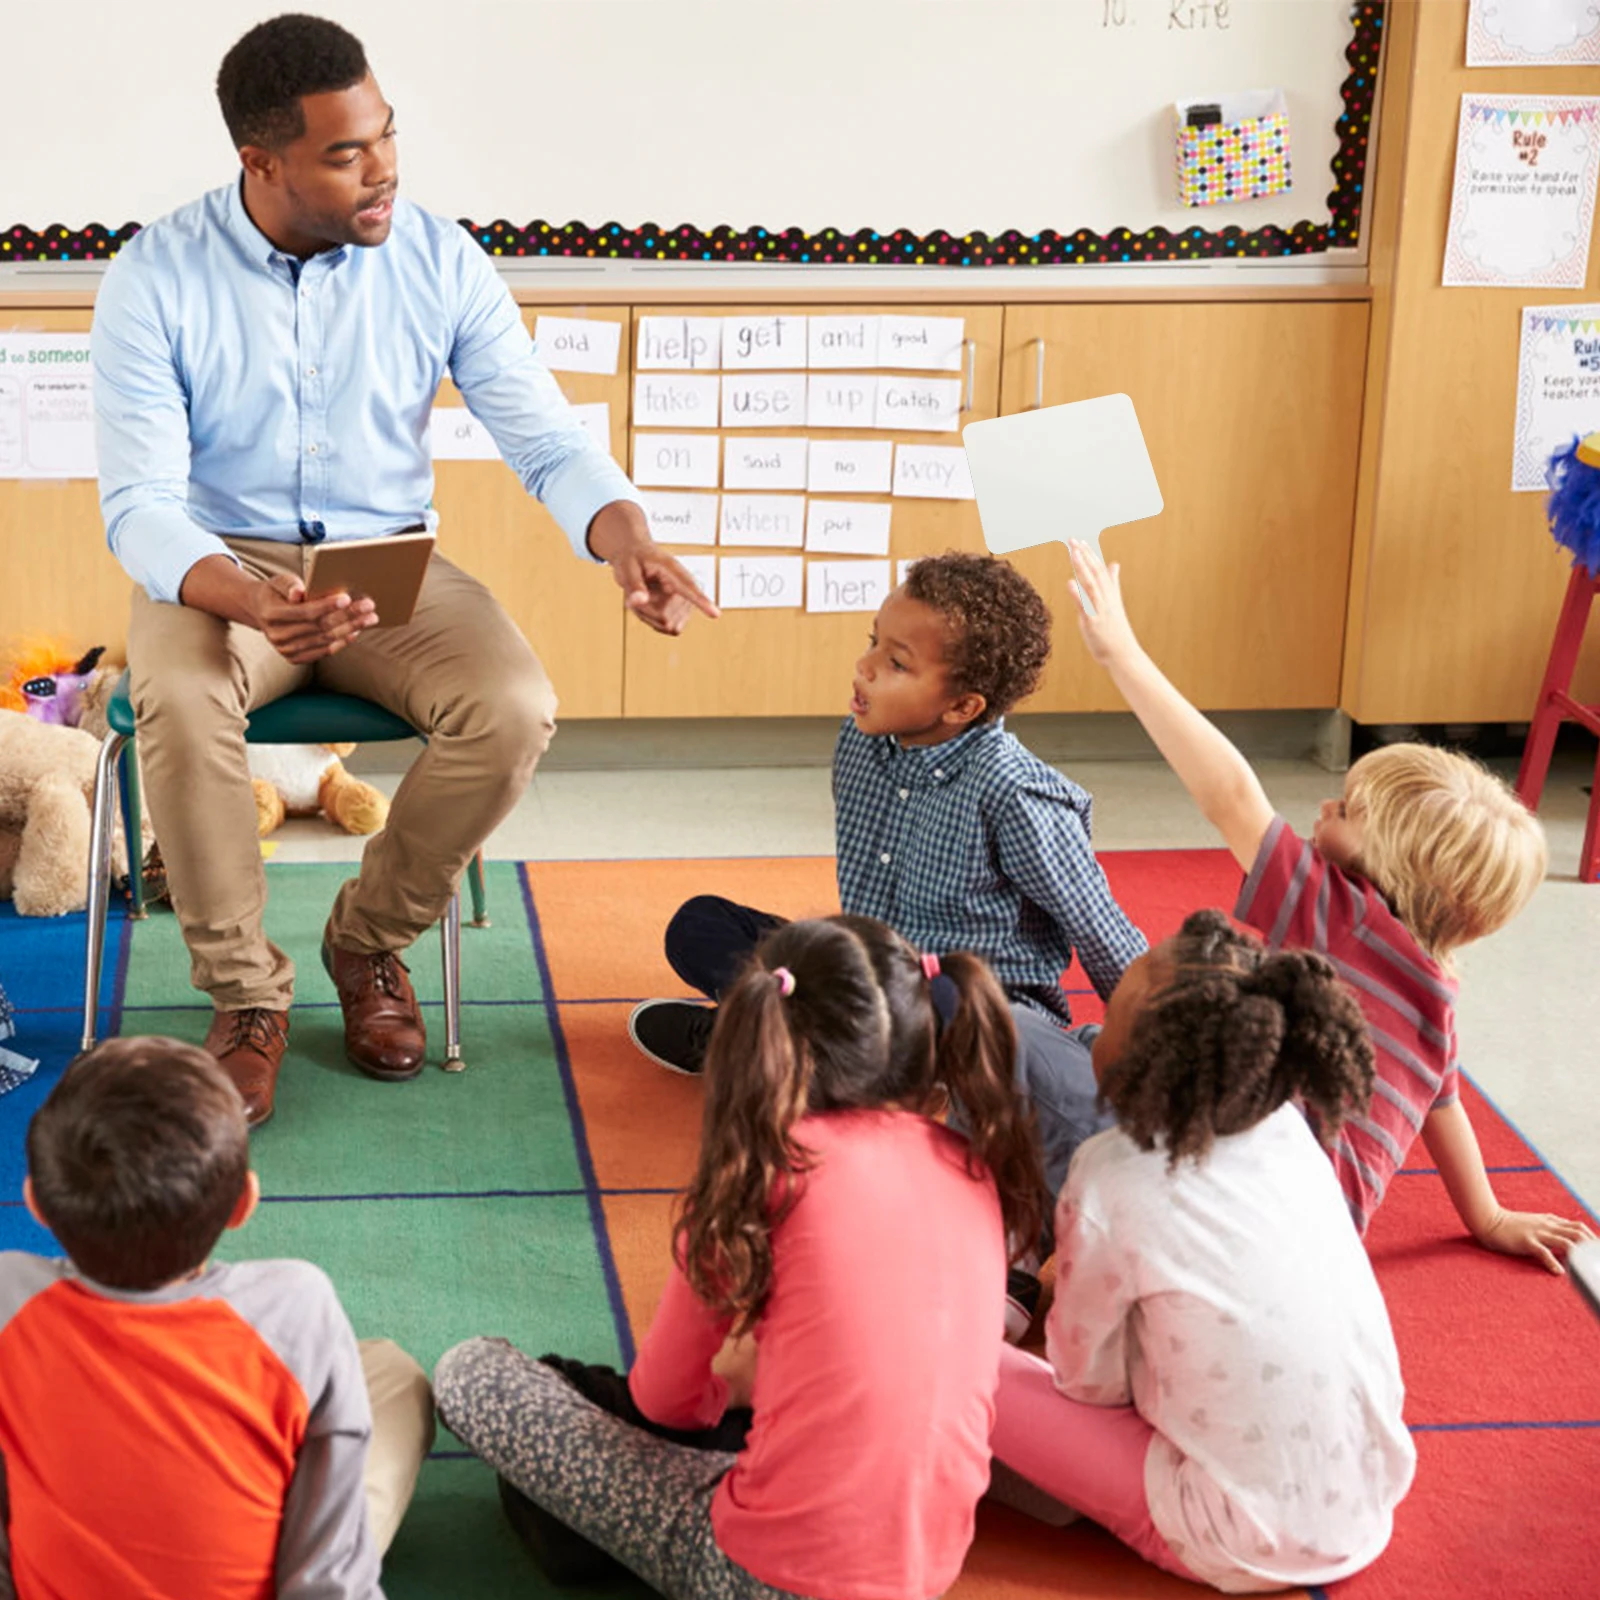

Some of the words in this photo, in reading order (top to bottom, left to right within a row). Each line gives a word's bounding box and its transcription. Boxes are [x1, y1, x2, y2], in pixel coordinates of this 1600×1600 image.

[1513, 130, 1546, 148] Rule
[1519, 149, 1539, 166] #2
[1471, 170, 1502, 181] Raise
[1506, 172, 1530, 184] your
[1534, 171, 1560, 182] hand
[1562, 171, 1579, 182] for
[1470, 185, 1526, 196] permission
[1530, 184, 1541, 194] to
[1546, 184, 1577, 196] speak
[554, 333, 589, 352] old
[644, 318, 707, 368] help
[737, 318, 785, 358] get
[821, 322, 864, 349] and
[892, 328, 928, 348] good
[1574, 338, 1600, 355] Rul
[1544, 375, 1573, 388] Keep
[645, 384, 699, 413] take
[733, 390, 790, 413] use
[827, 388, 863, 412] up
[886, 388, 940, 410] Catch
[1543, 388, 1588, 400] teacher
[656, 447, 692, 470] on
[743, 453, 782, 469] said
[834, 461, 855, 473] no
[901, 460, 956, 487] way
[651, 508, 692, 525] want
[724, 505, 790, 532] when
[824, 518, 852, 535] put
[736, 563, 784, 598] too
[823, 567, 876, 605] her
